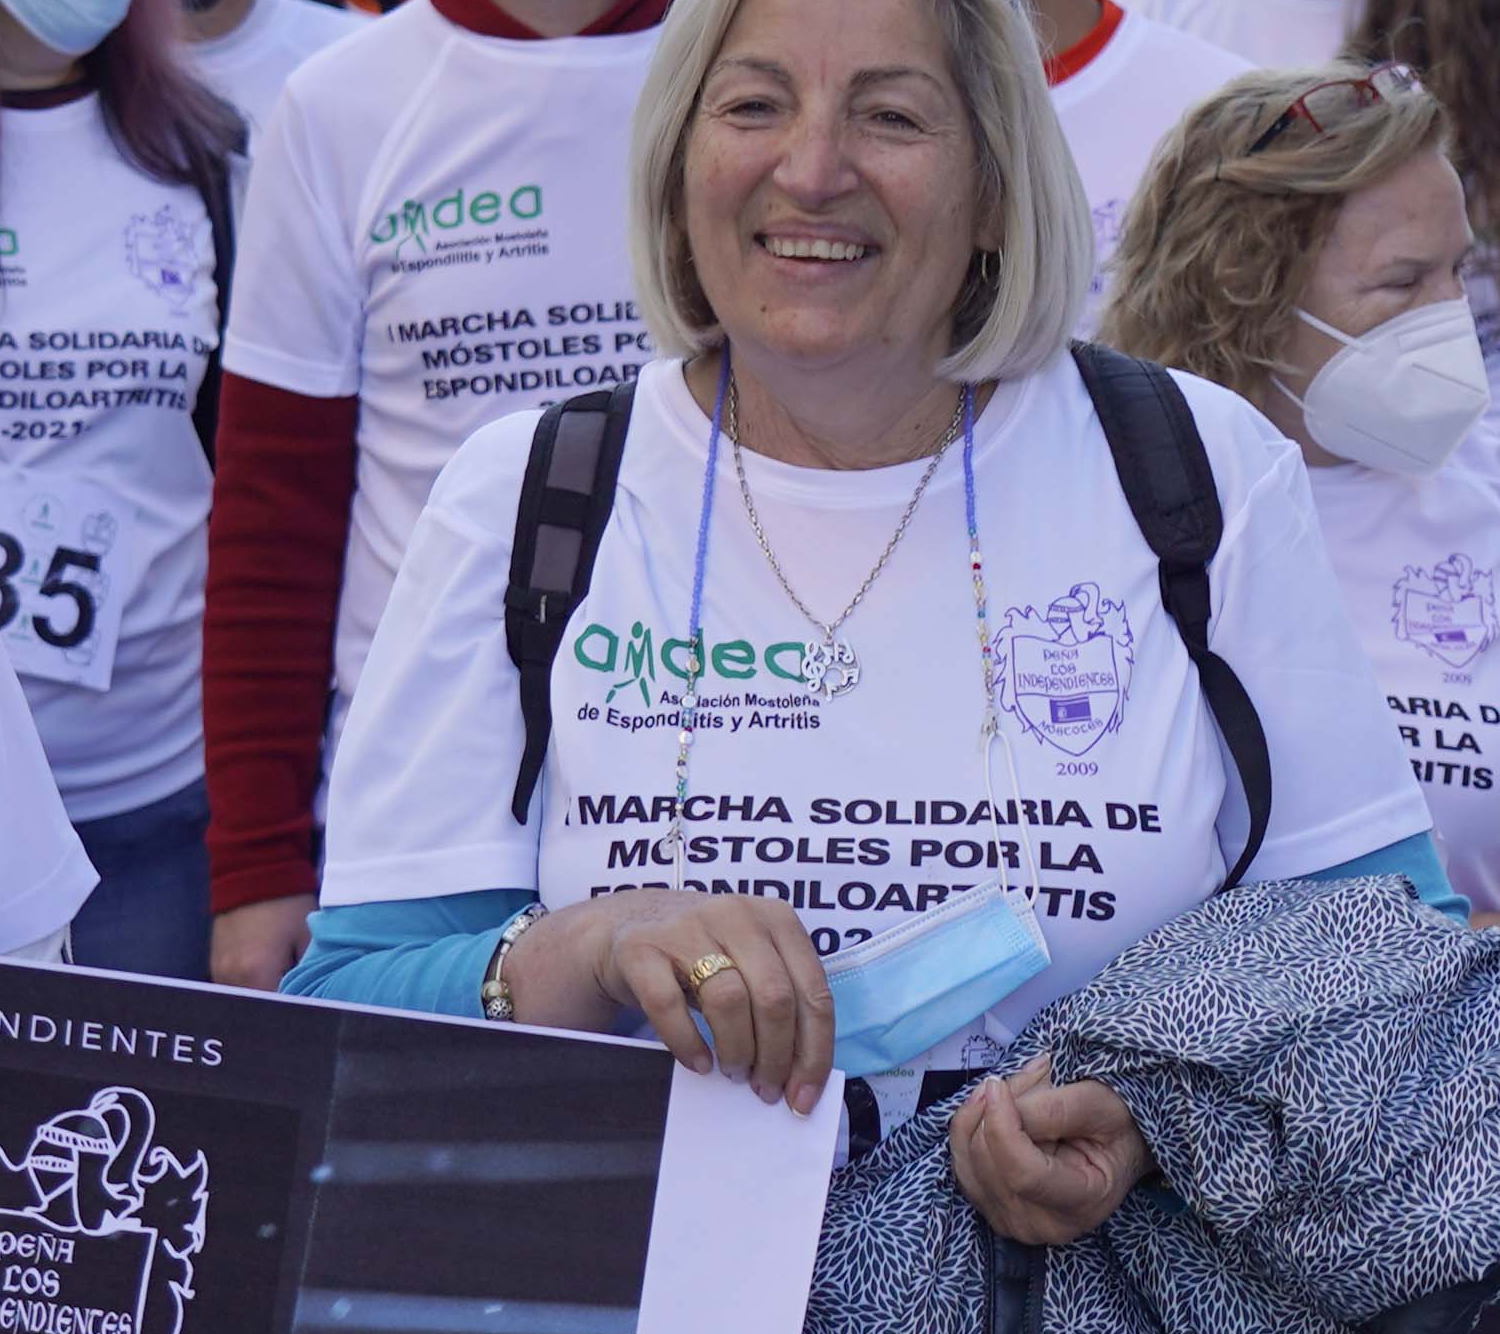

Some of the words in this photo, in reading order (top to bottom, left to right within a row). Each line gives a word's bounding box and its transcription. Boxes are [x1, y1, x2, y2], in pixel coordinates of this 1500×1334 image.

[28, 330, 188, 352] SOLIDARIA
[397, 309, 537, 344] MARCHA
[422, 331, 603, 370] MÓSTOLES
[87, 359, 150, 380] POR
[159, 361, 188, 380] LA
[424, 364, 640, 400] ESPONDILOAR
[745, 692, 821, 709] Mostoleña
[577, 703, 600, 722] de
[731, 716, 743, 733] y
[748, 710, 821, 730] Artritis
[1435, 729, 1482, 755] LA
[1055, 762, 1100, 777] 2009
[577, 795, 793, 825] MARCHA
[809, 796, 1093, 828] SOLIDARIA
[1106, 803, 1163, 834] DE
[909, 838, 1019, 870] POR
[1040, 843, 1104, 875] LA
